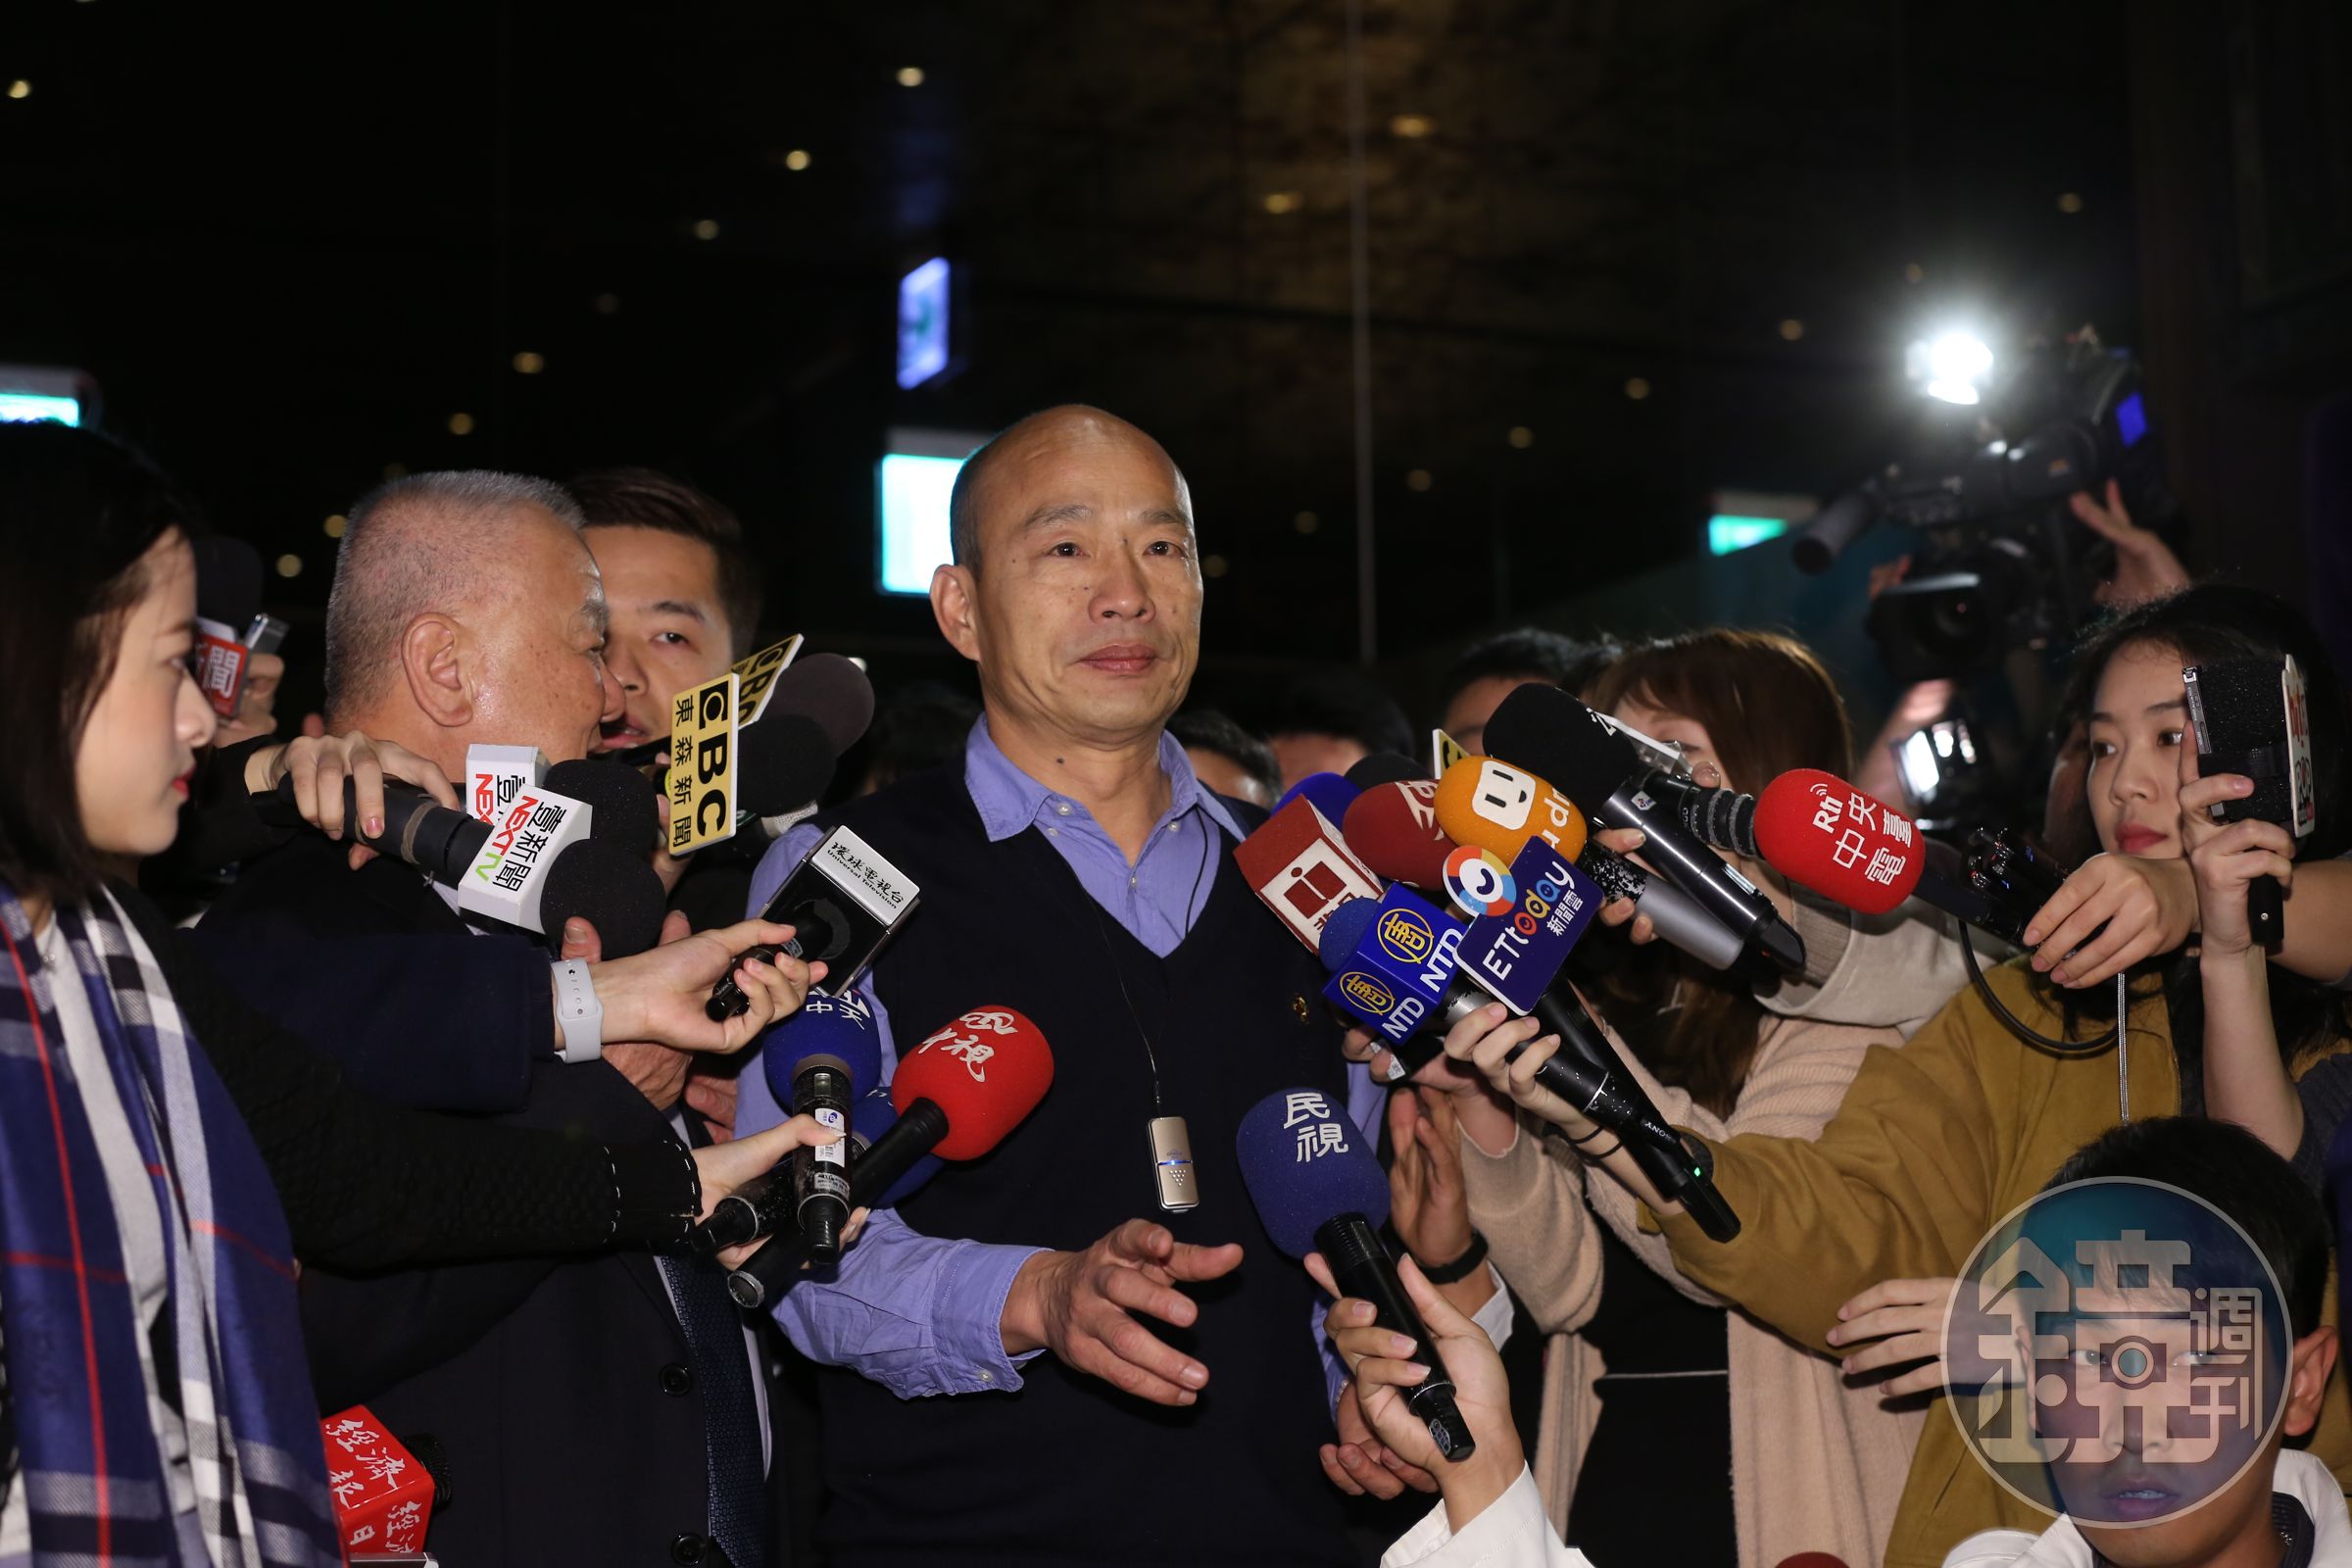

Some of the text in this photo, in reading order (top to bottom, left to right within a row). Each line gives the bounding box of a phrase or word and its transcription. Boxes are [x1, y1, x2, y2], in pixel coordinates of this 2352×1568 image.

[672, 694, 694, 847] 東森新聞
[492, 801, 567, 892] 壹新聞
[1832, 792, 1878, 869] 中央
[827, 849, 897, 909] Universal Television
[831, 841, 904, 904] 環球電視台
[1482, 860, 1576, 981] ETtoday
[1545, 889, 1585, 938] 新聞雲
[1419, 928, 1465, 994] NTD
[1381, 997, 1425, 1040] NTD
[1283, 1092, 1349, 1163] 民視
